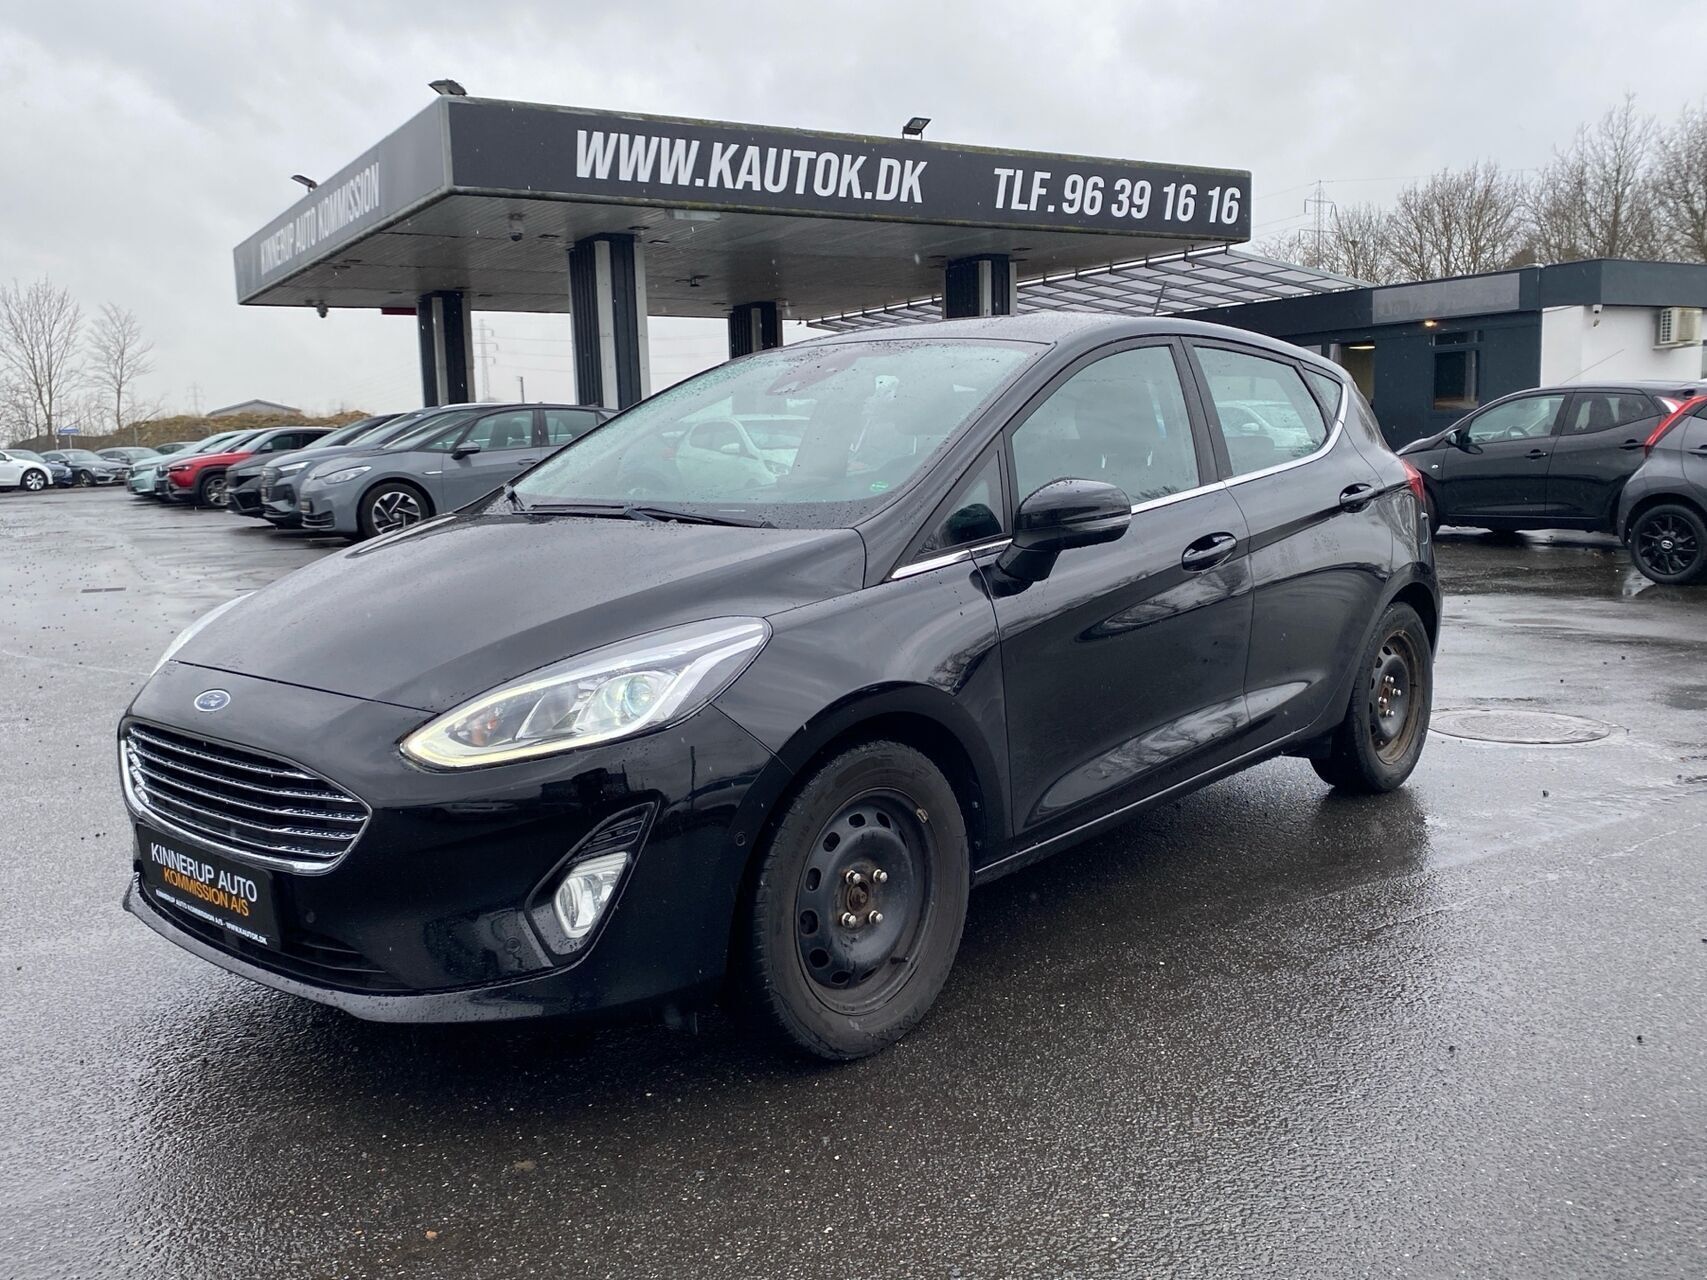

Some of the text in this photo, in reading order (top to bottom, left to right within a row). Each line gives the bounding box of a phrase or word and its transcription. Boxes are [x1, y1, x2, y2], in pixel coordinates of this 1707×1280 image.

[576, 130, 927, 203] WWW.KAUTOK.DK
[994, 168, 1241, 225] TLF. 96 39 16 16
[295, 207, 316, 255] AUTO
[318, 162, 380, 241] KOMMISSION
[151, 842, 257, 902] KINNERUP AUTO
[163, 867, 228, 908] KOMMISSION
